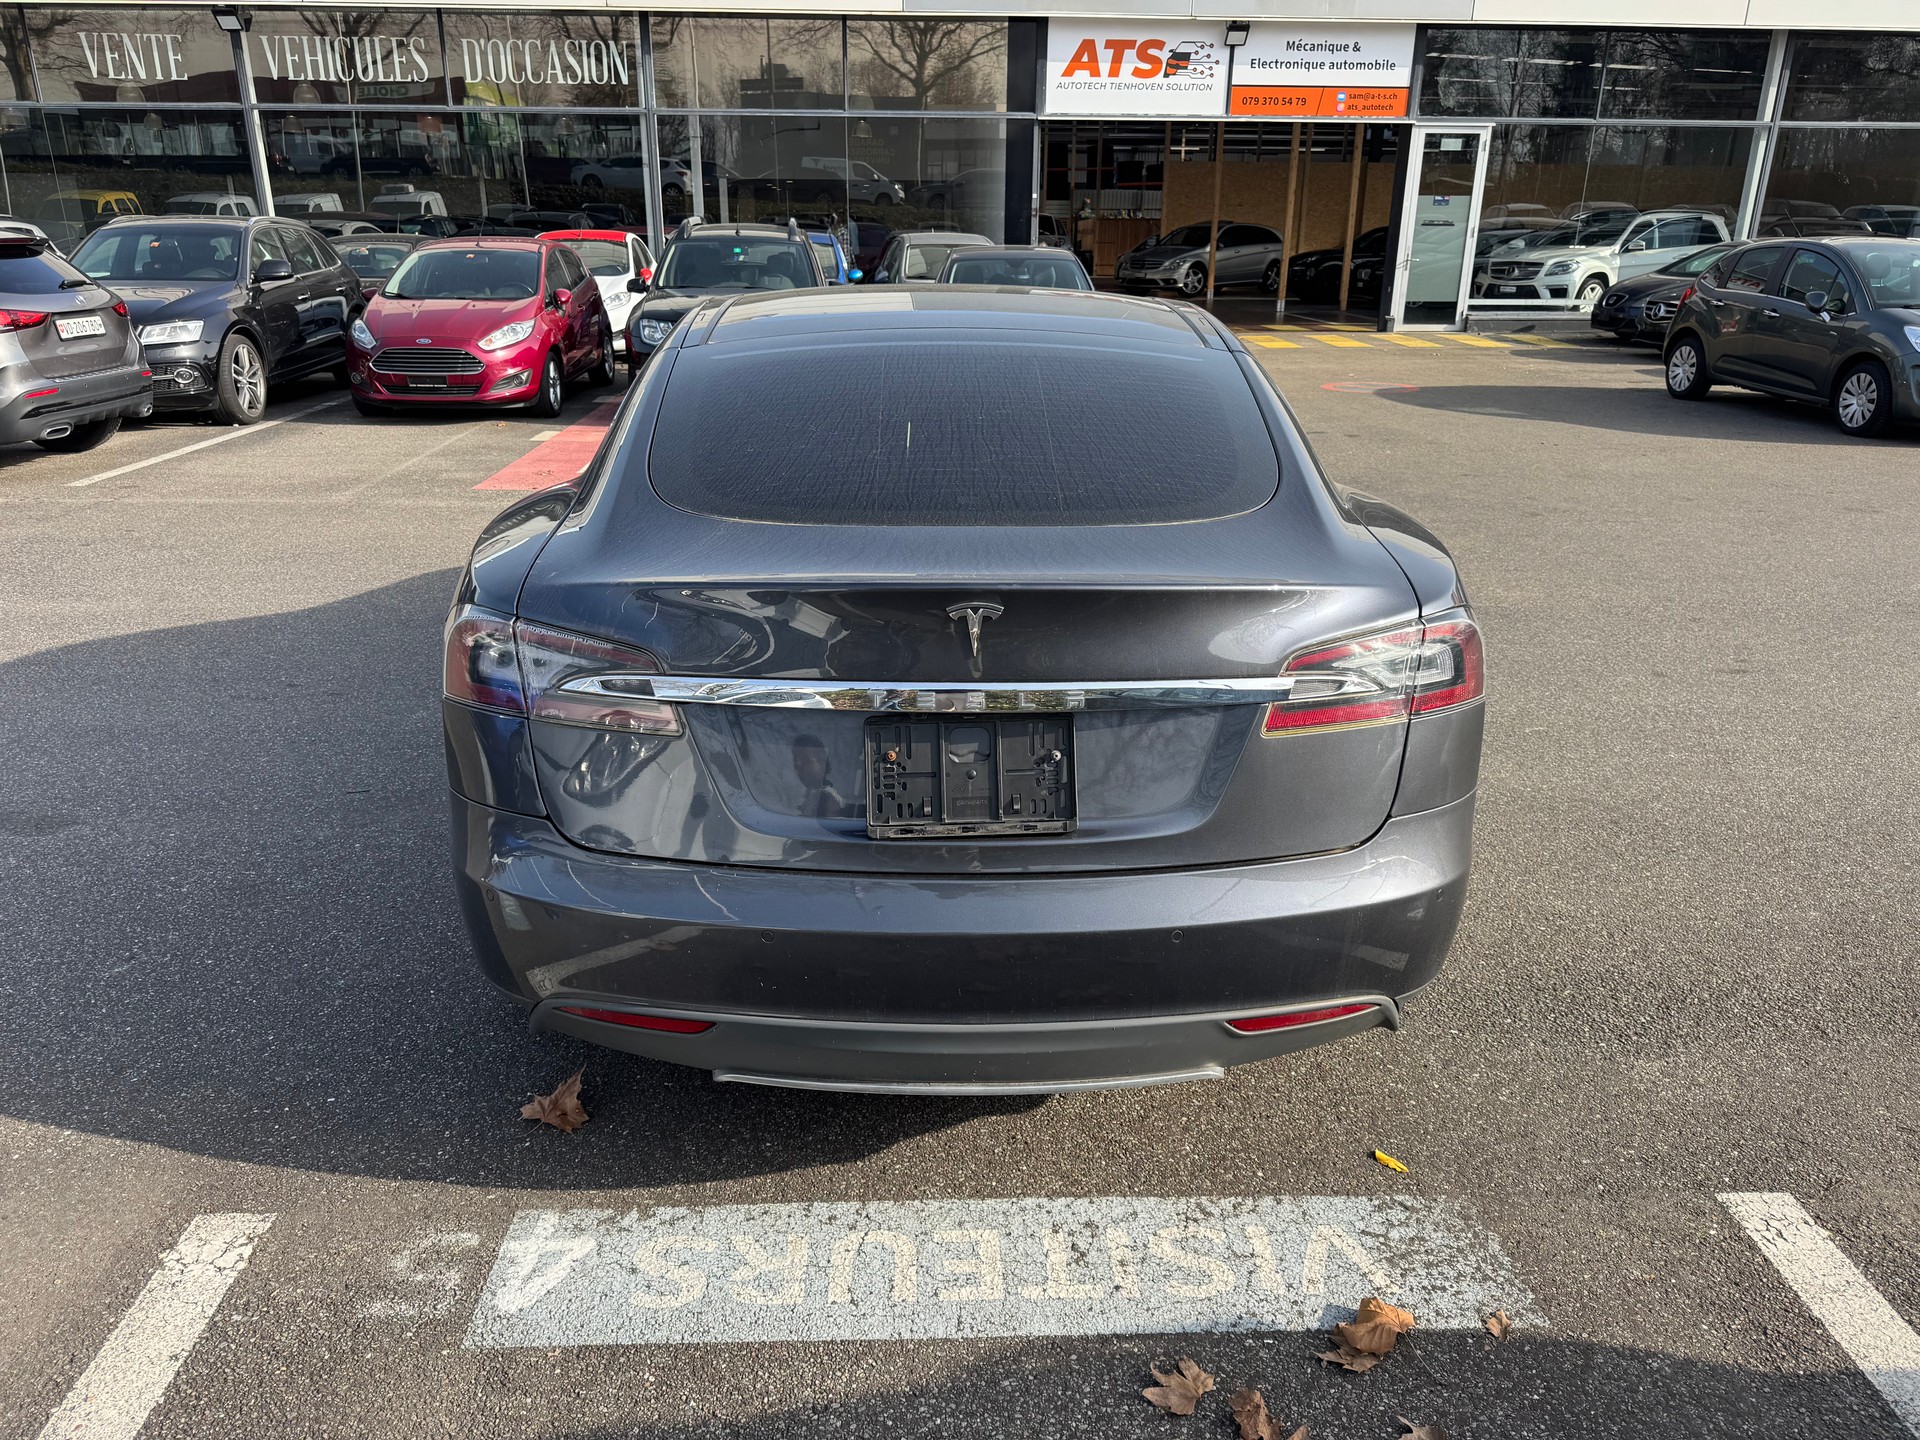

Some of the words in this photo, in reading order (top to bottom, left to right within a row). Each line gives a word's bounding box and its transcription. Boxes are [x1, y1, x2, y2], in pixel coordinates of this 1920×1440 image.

[1286, 39, 1350, 54] Mécanique
[1352, 41, 1361, 52] &
[77, 31, 189, 81] VENTE
[259, 34, 431, 83] VEHICULES
[462, 38, 630, 86] D'OCCASION
[1061, 38, 1167, 79] ATS
[1250, 58, 1325, 72] Electronique
[1328, 59, 1396, 71] automobile
[1056, 81, 1107, 90] AUTOTECH
[1109, 82, 1164, 91] TIENHOVEN
[1165, 83, 1213, 92] SOLUTION
[1242, 96, 1259, 106] 079
[1262, 97, 1279, 106] 370
[1281, 97, 1293, 106] 54
[1295, 97, 1307, 106] 79
[1347, 103, 1394, 112] ats_autotech
[632, 1223, 1400, 1311] VISITEURS
